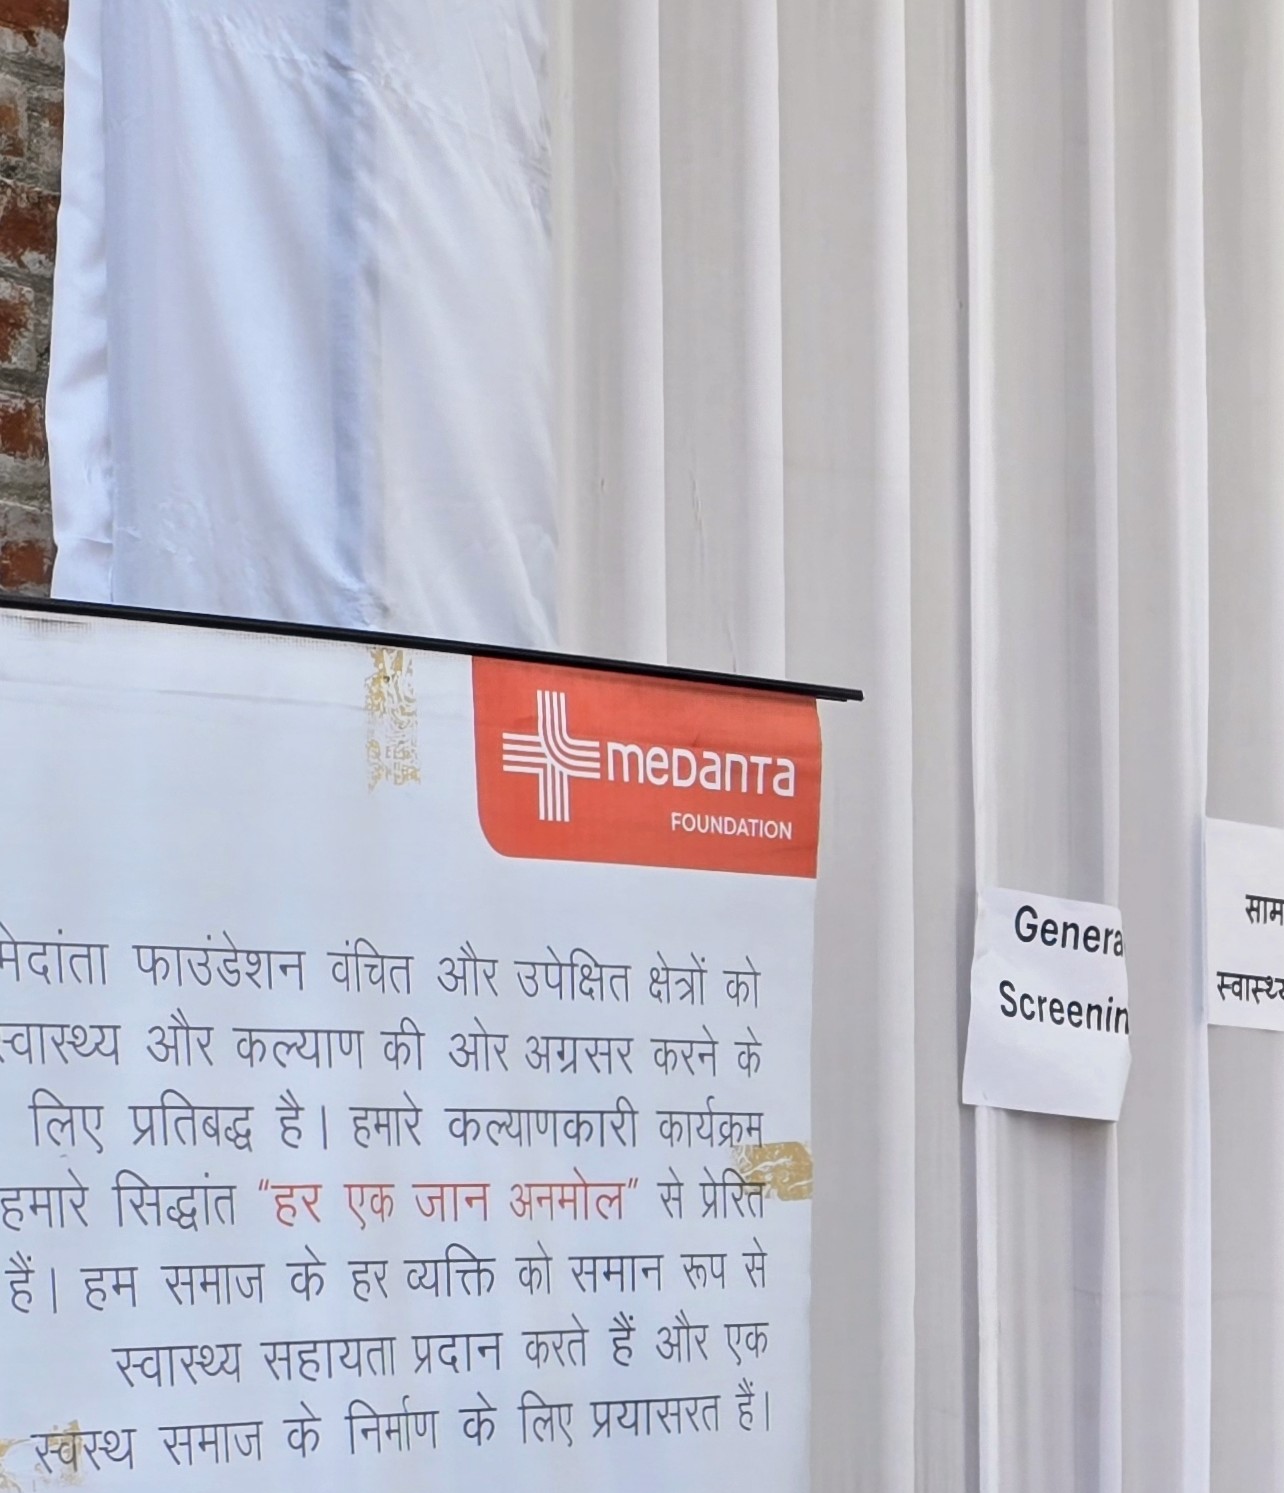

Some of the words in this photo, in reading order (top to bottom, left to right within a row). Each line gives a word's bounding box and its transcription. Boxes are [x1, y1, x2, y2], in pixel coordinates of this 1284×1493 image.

[671, 811, 793, 840] FOUNDATION
[1015, 905, 1123, 956] Genera
[0, 922, 109, 985] मेदांता
[132, 930, 306, 990] फाउंडेशन
[327, 938, 414, 994] वंचित
[438, 941, 498, 996] और
[514, 946, 631, 1002] उपेक्षित
[649, 951, 707, 1005] क्षेत्रों
[723, 956, 761, 1008] को
[1000, 980, 1129, 1034] Screenin
[0, 1023, 121, 1065] वास्थ्य
[147, 1008, 214, 1066] और
[232, 1028, 364, 1069] कल्याण
[380, 1017, 425, 1070] की
[449, 1016, 509, 1071] ओर
[525, 1036, 634, 1074] अग्रसर
[650, 1025, 719, 1076] करने
[734, 1026, 762, 1077] के
[28, 1088, 104, 1154] लिए
[128, 1089, 254, 1152] प्रतिबद्ध
[349, 1091, 423, 1148] हमारे
[444, 1096, 639, 1147] कल्याणकारी
[656, 1096, 767, 1153] कार्यक्रम
[0, 1168, 89, 1231] हमारे
[112, 1169, 237, 1231] सिद्धांत
[344, 1184, 395, 1230] एक
[412, 1184, 490, 1221] जान
[657, 1167, 684, 1218] से
[699, 1167, 767, 1218] प्रेरित
[80, 1267, 138, 1311] हम
[160, 1264, 265, 1305] समाज
[286, 1245, 326, 1301] के
[348, 1261, 388, 1302] हर
[403, 1243, 496, 1297] व्यक्ति
[515, 1241, 553, 1294] को
[568, 1255, 664, 1292] समान
[680, 1254, 727, 1289] रूप
[742, 1237, 768, 1288] से
[112, 1344, 242, 1387] स्वास्थ्य
[260, 1337, 396, 1381] सहायता
[411, 1333, 503, 1373] प्रदान
[522, 1313, 589, 1368] करते
[609, 1311, 636, 1366] हैं
[656, 1309, 709, 1362] और
[724, 1323, 769, 1365] एक
[30, 1429, 137, 1473] स्वस्थ
[158, 1421, 263, 1465] समाज
[283, 1401, 321, 1457] के
[344, 1395, 439, 1454] निर्माण
[459, 1392, 497, 1446] के
[517, 1390, 573, 1447] लिए
[590, 1395, 721, 1437] प्रयासरत
